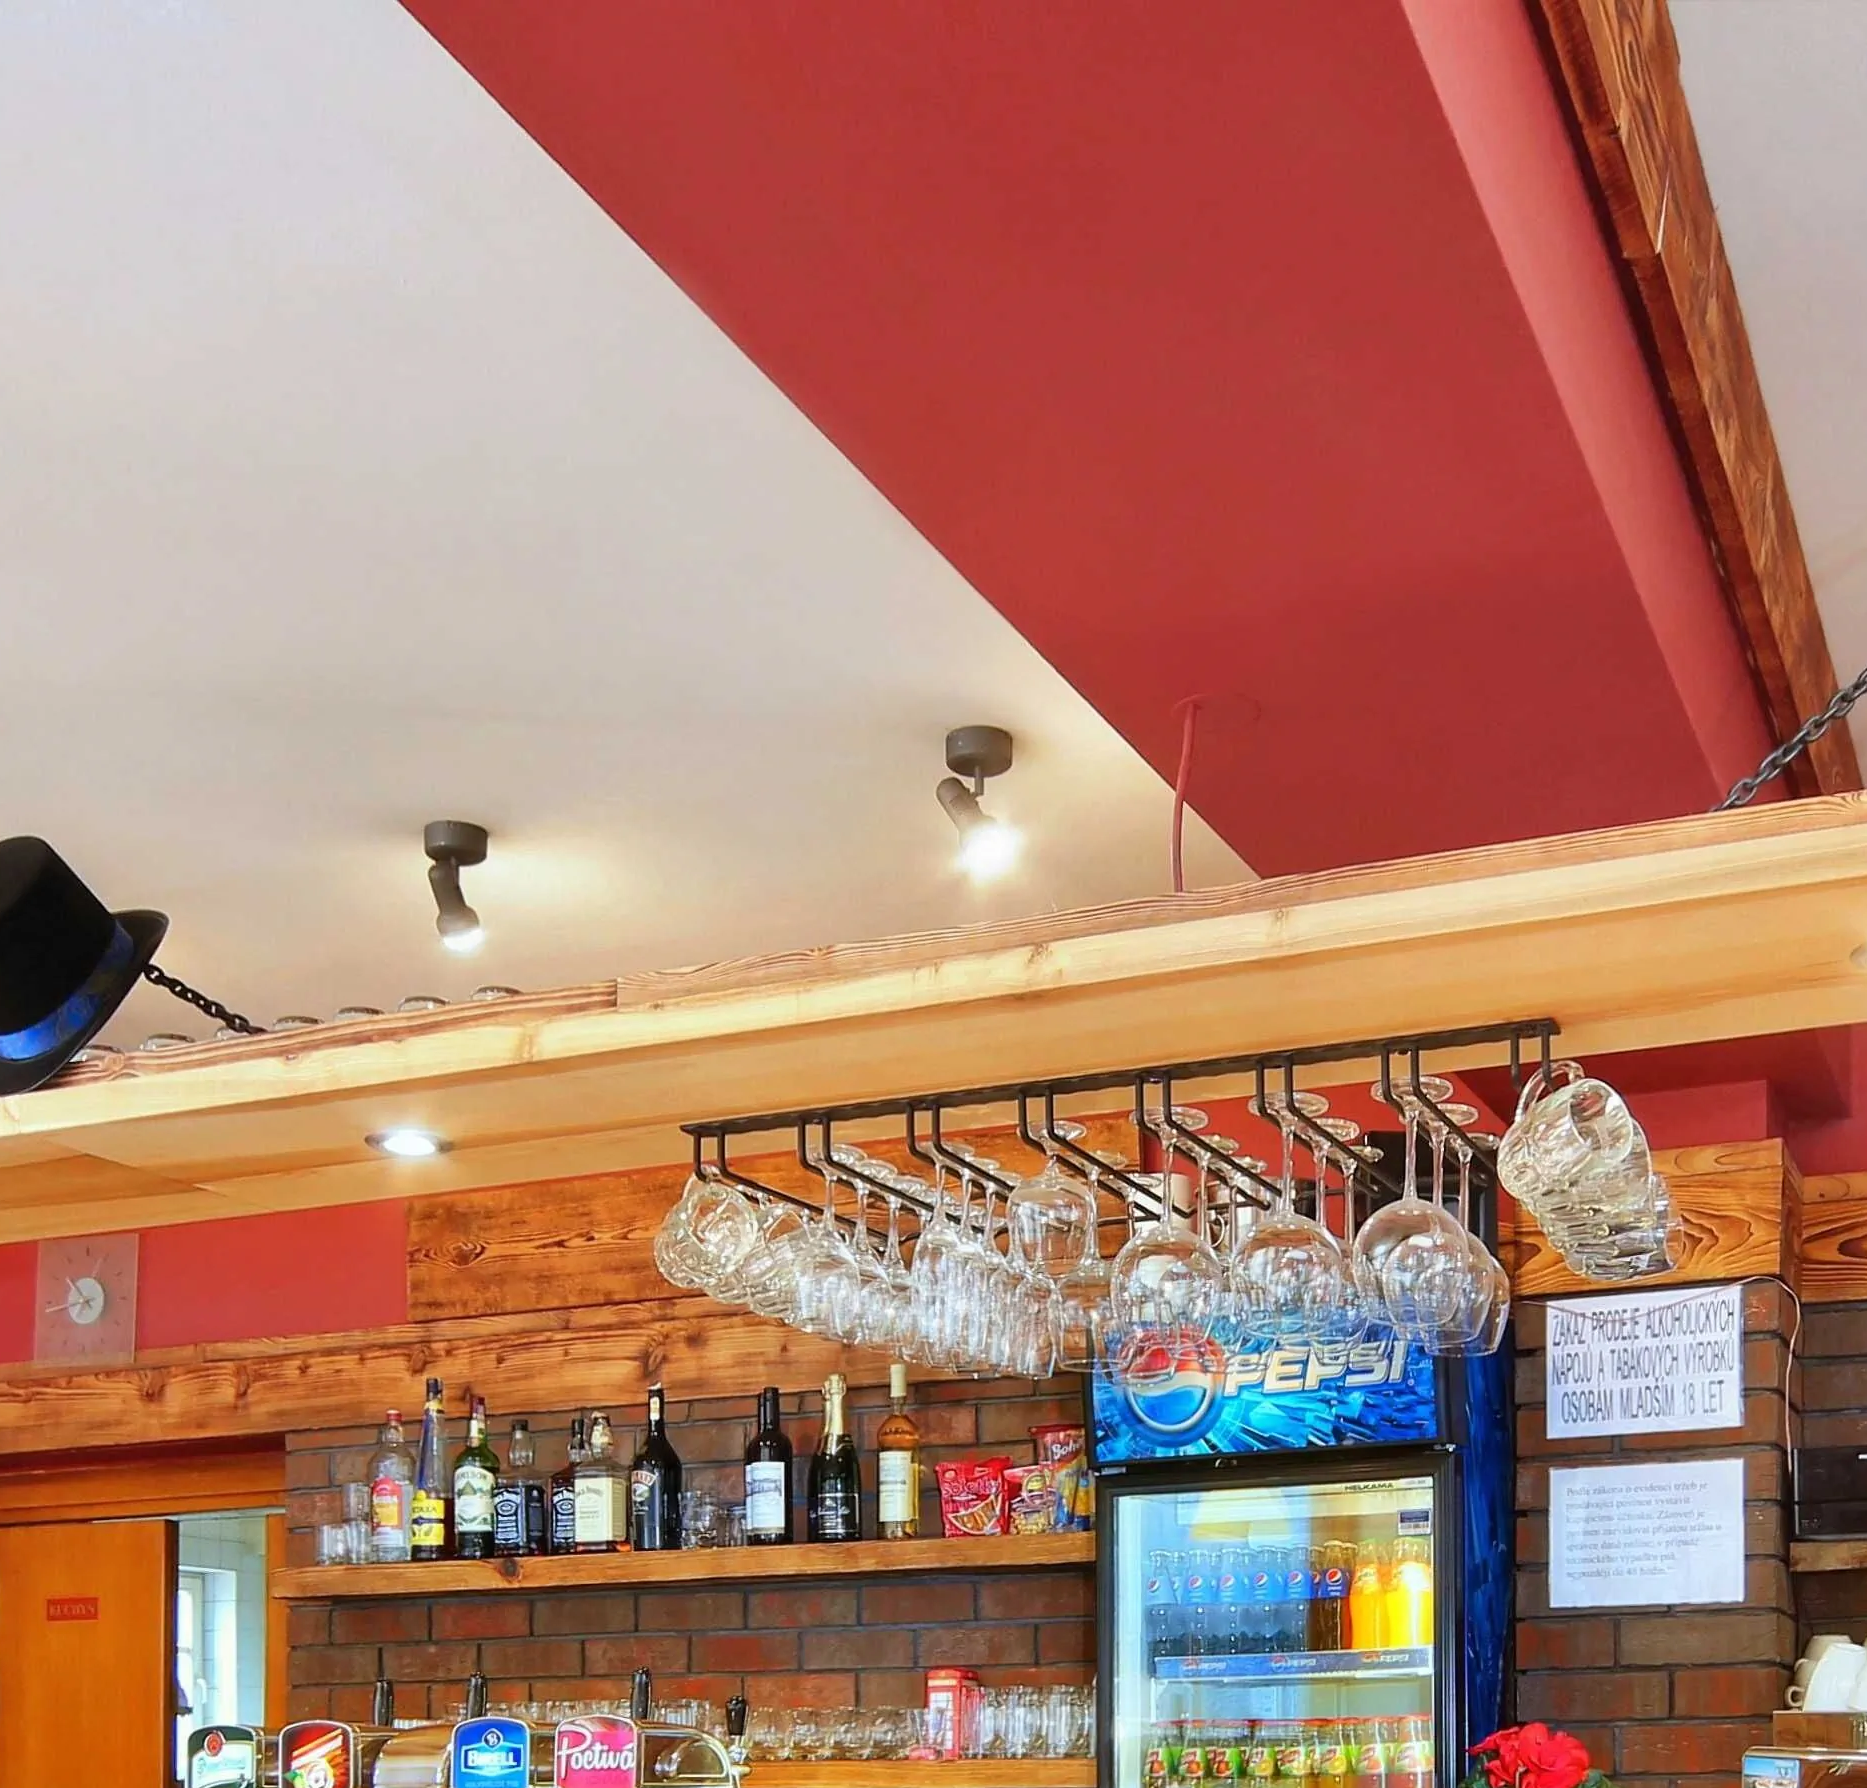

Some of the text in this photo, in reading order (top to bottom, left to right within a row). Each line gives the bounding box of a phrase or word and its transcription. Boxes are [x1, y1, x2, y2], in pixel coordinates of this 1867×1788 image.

[1591, 1307, 1641, 1342] PRODEJE
[1223, 1340, 1409, 1397] PEPSI
[1597, 1350, 1605, 1381] A
[1682, 1383, 1695, 1415] 18
[1702, 1380, 1724, 1414] LET
[557, 1722, 635, 1780] Poctivá
